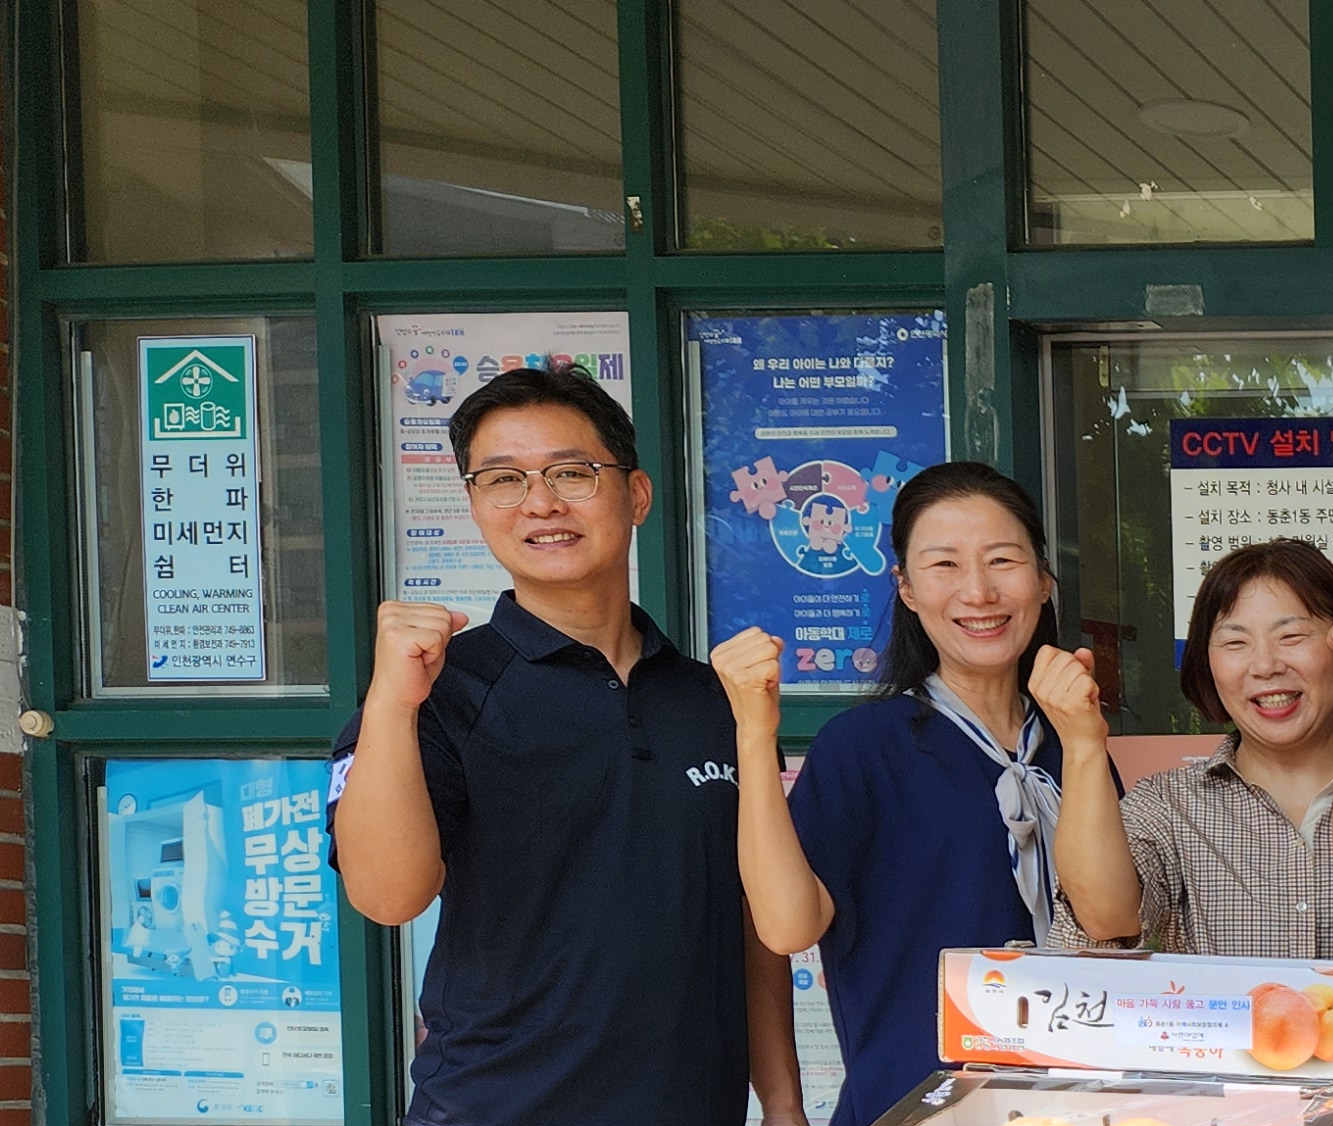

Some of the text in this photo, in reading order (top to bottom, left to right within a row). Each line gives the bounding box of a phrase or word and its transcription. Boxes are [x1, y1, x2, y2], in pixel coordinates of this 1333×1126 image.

[753, 360, 764, 370] 왜
[767, 358, 789, 370] 우리
[793, 358, 826, 370] 아이는
[829, 357, 851, 369] 나와
[773, 375, 875, 389] 나는 어떤 부모일까?
[1182, 432, 1259, 457] CCTV
[1270, 429, 1319, 457] 설치
[1198, 481, 1222, 496] 설치
[1226, 480, 1251, 496] 목적
[1266, 479, 1291, 495] 청사
[1296, 480, 1307, 495] 내
[1198, 509, 1223, 525] 설치
[1227, 509, 1252, 525] 장소
[1267, 509, 1311, 524] 동춘1동
[154, 521, 248, 545] 미세먼지
[1199, 535, 1223, 551] 촬영
[153, 589, 253, 599] COOLING, WARMING
[158, 604, 249, 613] CLEAN AIR CENTER
[193, 625, 223, 635] 안전관리과
[795, 627, 873, 641] 아동학대 제로
[172, 655, 257, 667] 인천광역시 연수구
[240, 778, 274, 802] 대형
[241, 790, 321, 831] 폐가전
[244, 827, 323, 875] 무상
[243, 876, 323, 919] 방문
[245, 920, 322, 966] 수거
[1033, 982, 1115, 1033] 김천
